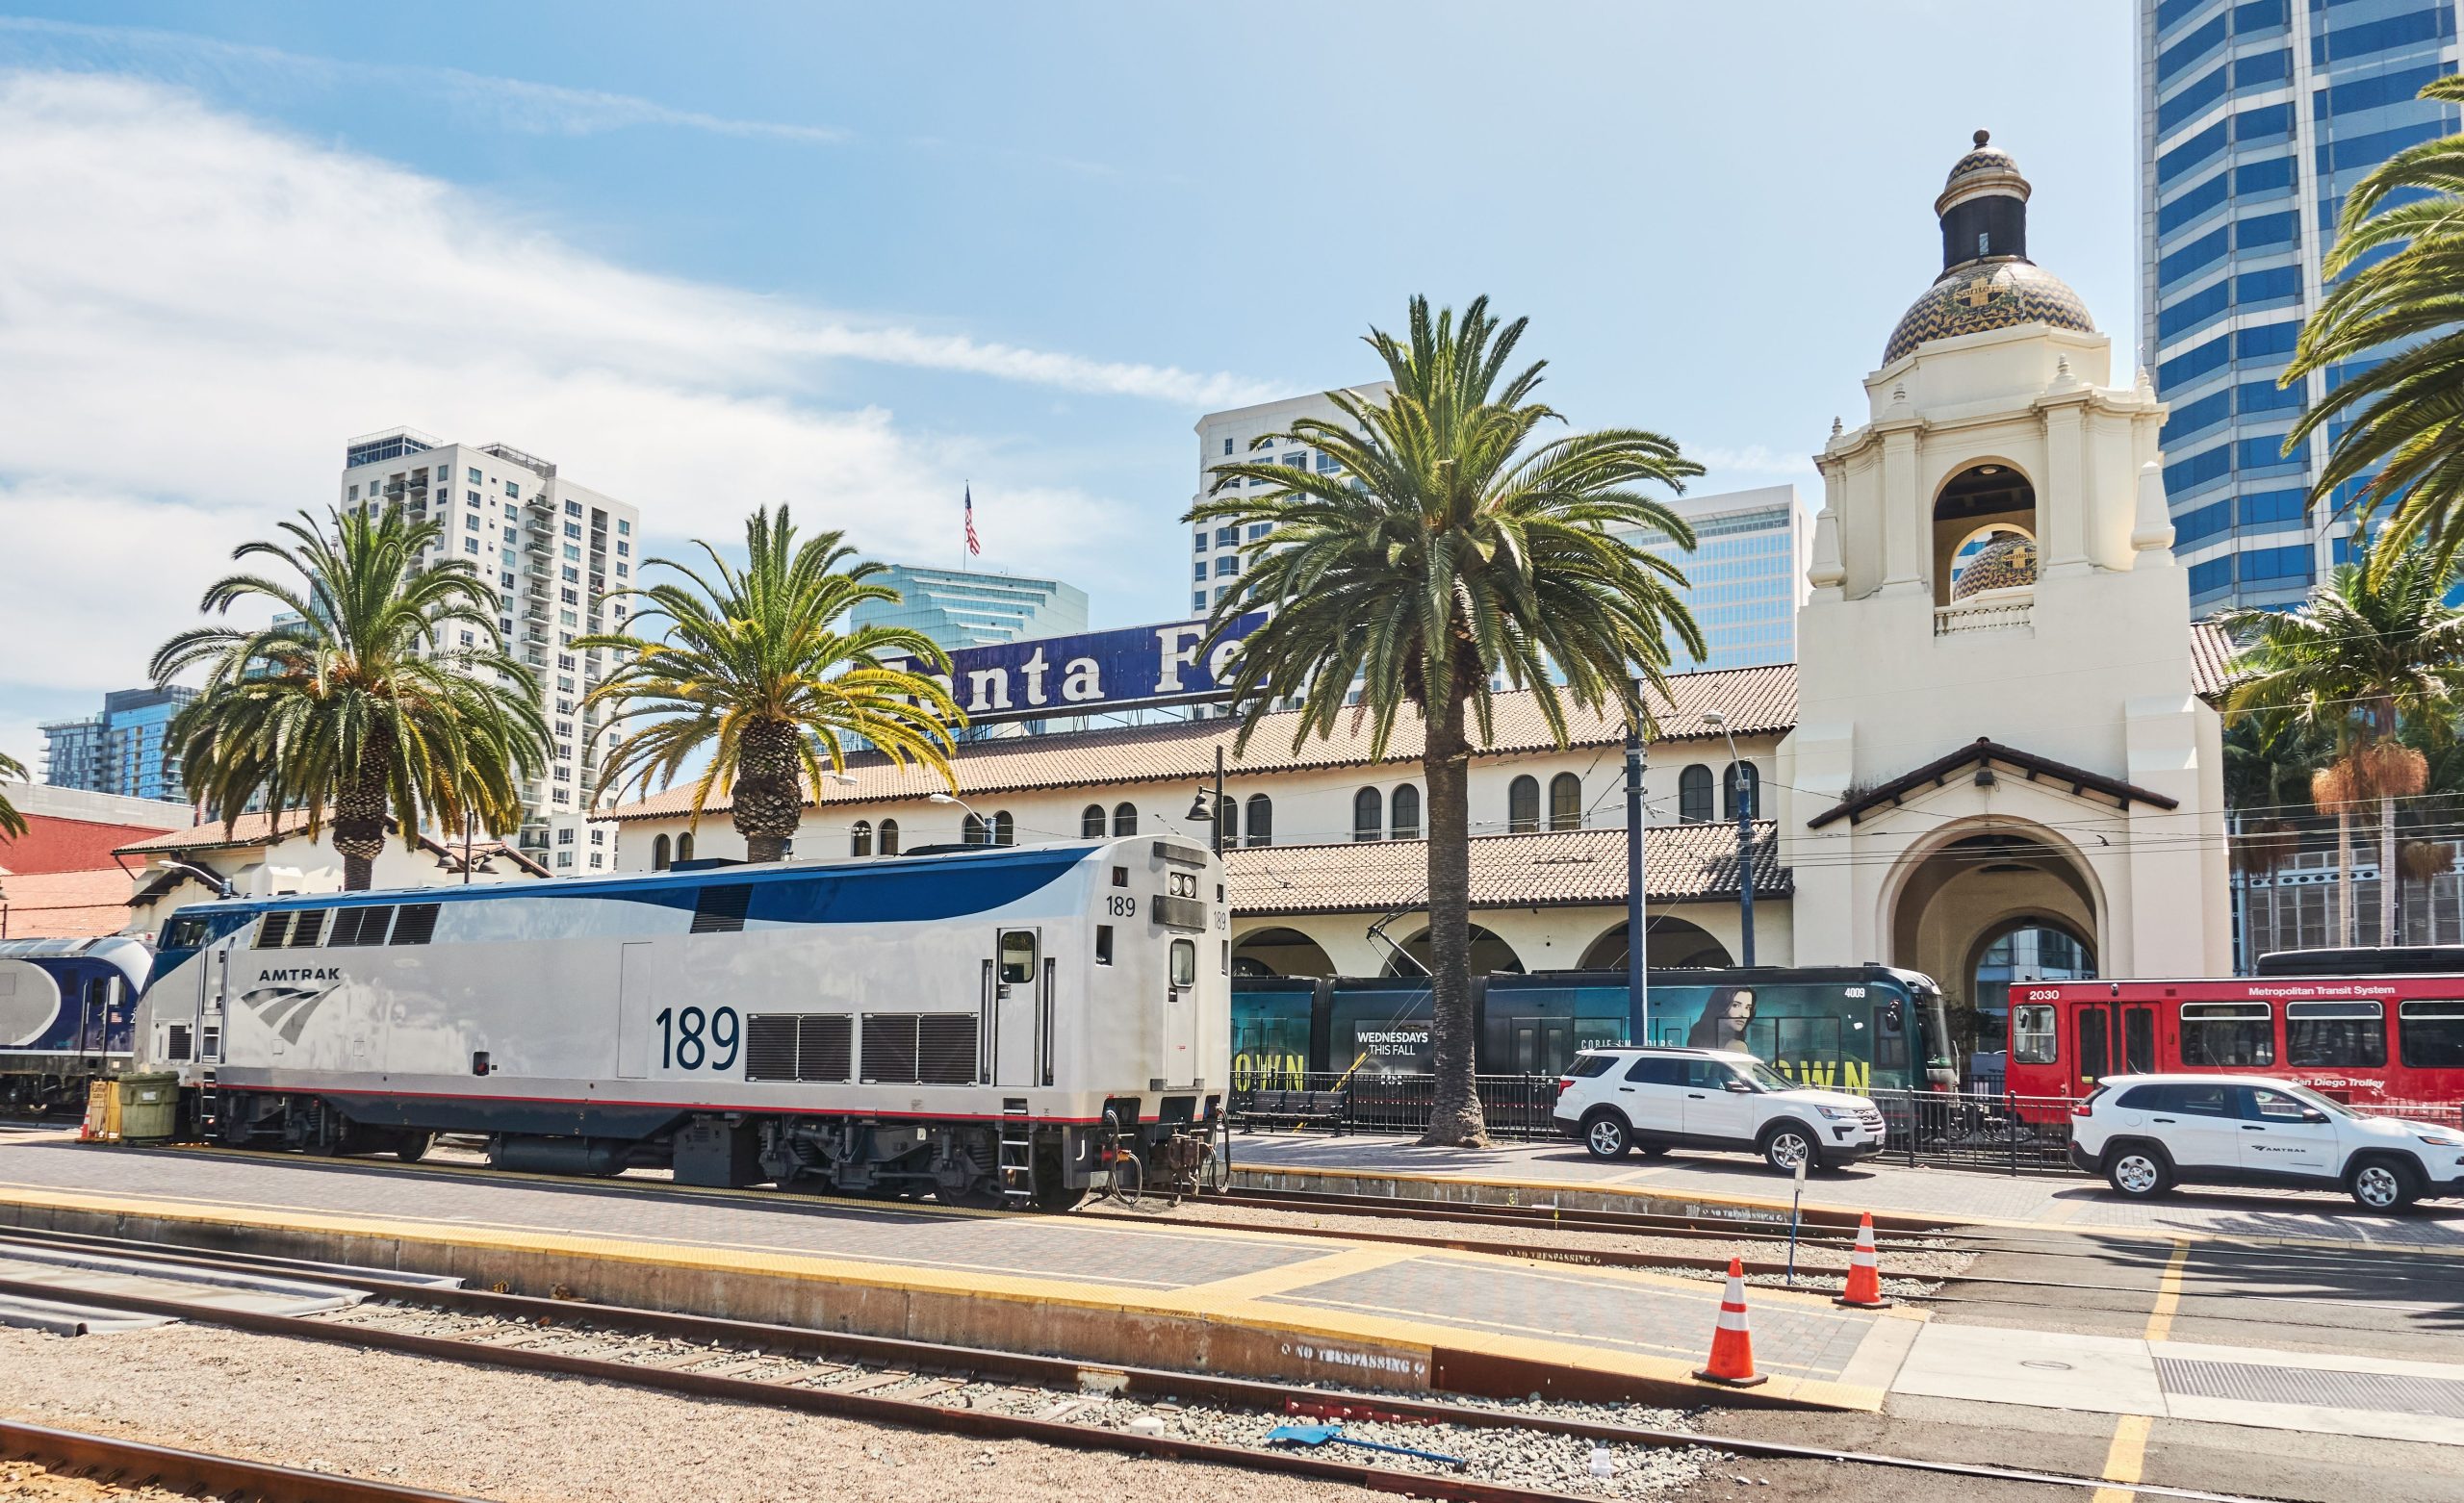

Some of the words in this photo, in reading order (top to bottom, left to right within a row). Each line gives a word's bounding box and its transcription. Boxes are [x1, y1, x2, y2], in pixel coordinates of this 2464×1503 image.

[1156, 623, 1249, 692] Fe
[1107, 895, 1136, 918] 189
[1214, 910, 1227, 930] 189
[259, 968, 340, 981] AMTRAK
[1844, 987, 1865, 998] 4009
[2029, 990, 2060, 1000] 2030
[2248, 987, 2314, 997] Metropolitan
[2316, 986, 2351, 995] Transit
[2354, 985, 2396, 995] System
[655, 1006, 740, 1071] 189
[1357, 1032, 1428, 1043] WEDNESDAYS
[1369, 1044, 1391, 1056] THIS
[1392, 1044, 1416, 1056] FALL
[2291, 1078, 2312, 1086] San
[2314, 1078, 2347, 1088] Diego
[2348, 1078, 2385, 1089] Trolley
[1530, 1251, 1591, 1263] TRESPASSING
[1296, 1344, 1313, 1360] NO
[1318, 1349, 1410, 1373] TRESPASSING
